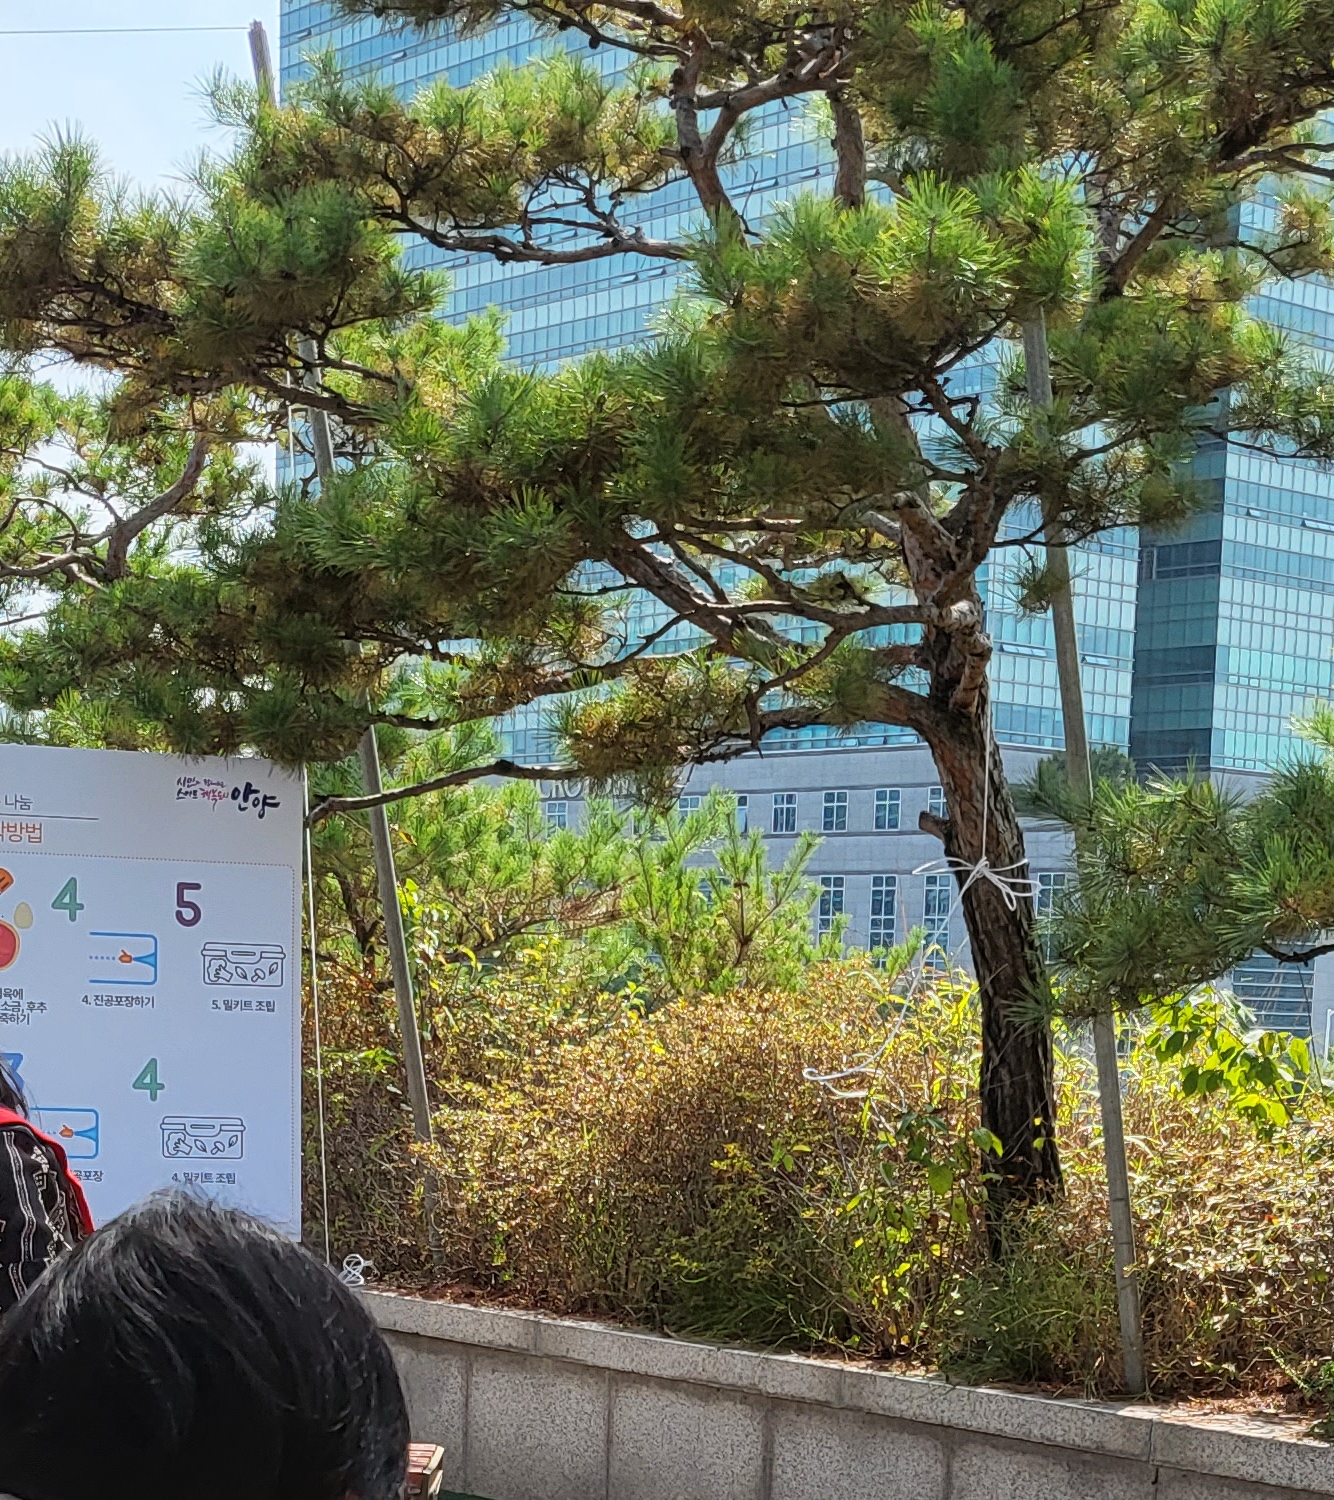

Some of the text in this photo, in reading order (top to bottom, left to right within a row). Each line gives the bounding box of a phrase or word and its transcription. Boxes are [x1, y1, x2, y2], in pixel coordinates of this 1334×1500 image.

[4, 794, 33, 811] 나눔
[230, 781, 281, 819] 안양
[51, 877, 84, 922] 4
[175, 882, 202, 927] 5
[26, 1000, 47, 1013] 후추
[81, 994, 155, 1009] 4. 진공포장하기
[211, 999, 276, 1013] 5. 밀키트 조립
[132, 1057, 165, 1102] 4
[215, 1171, 236, 1184] 조립
